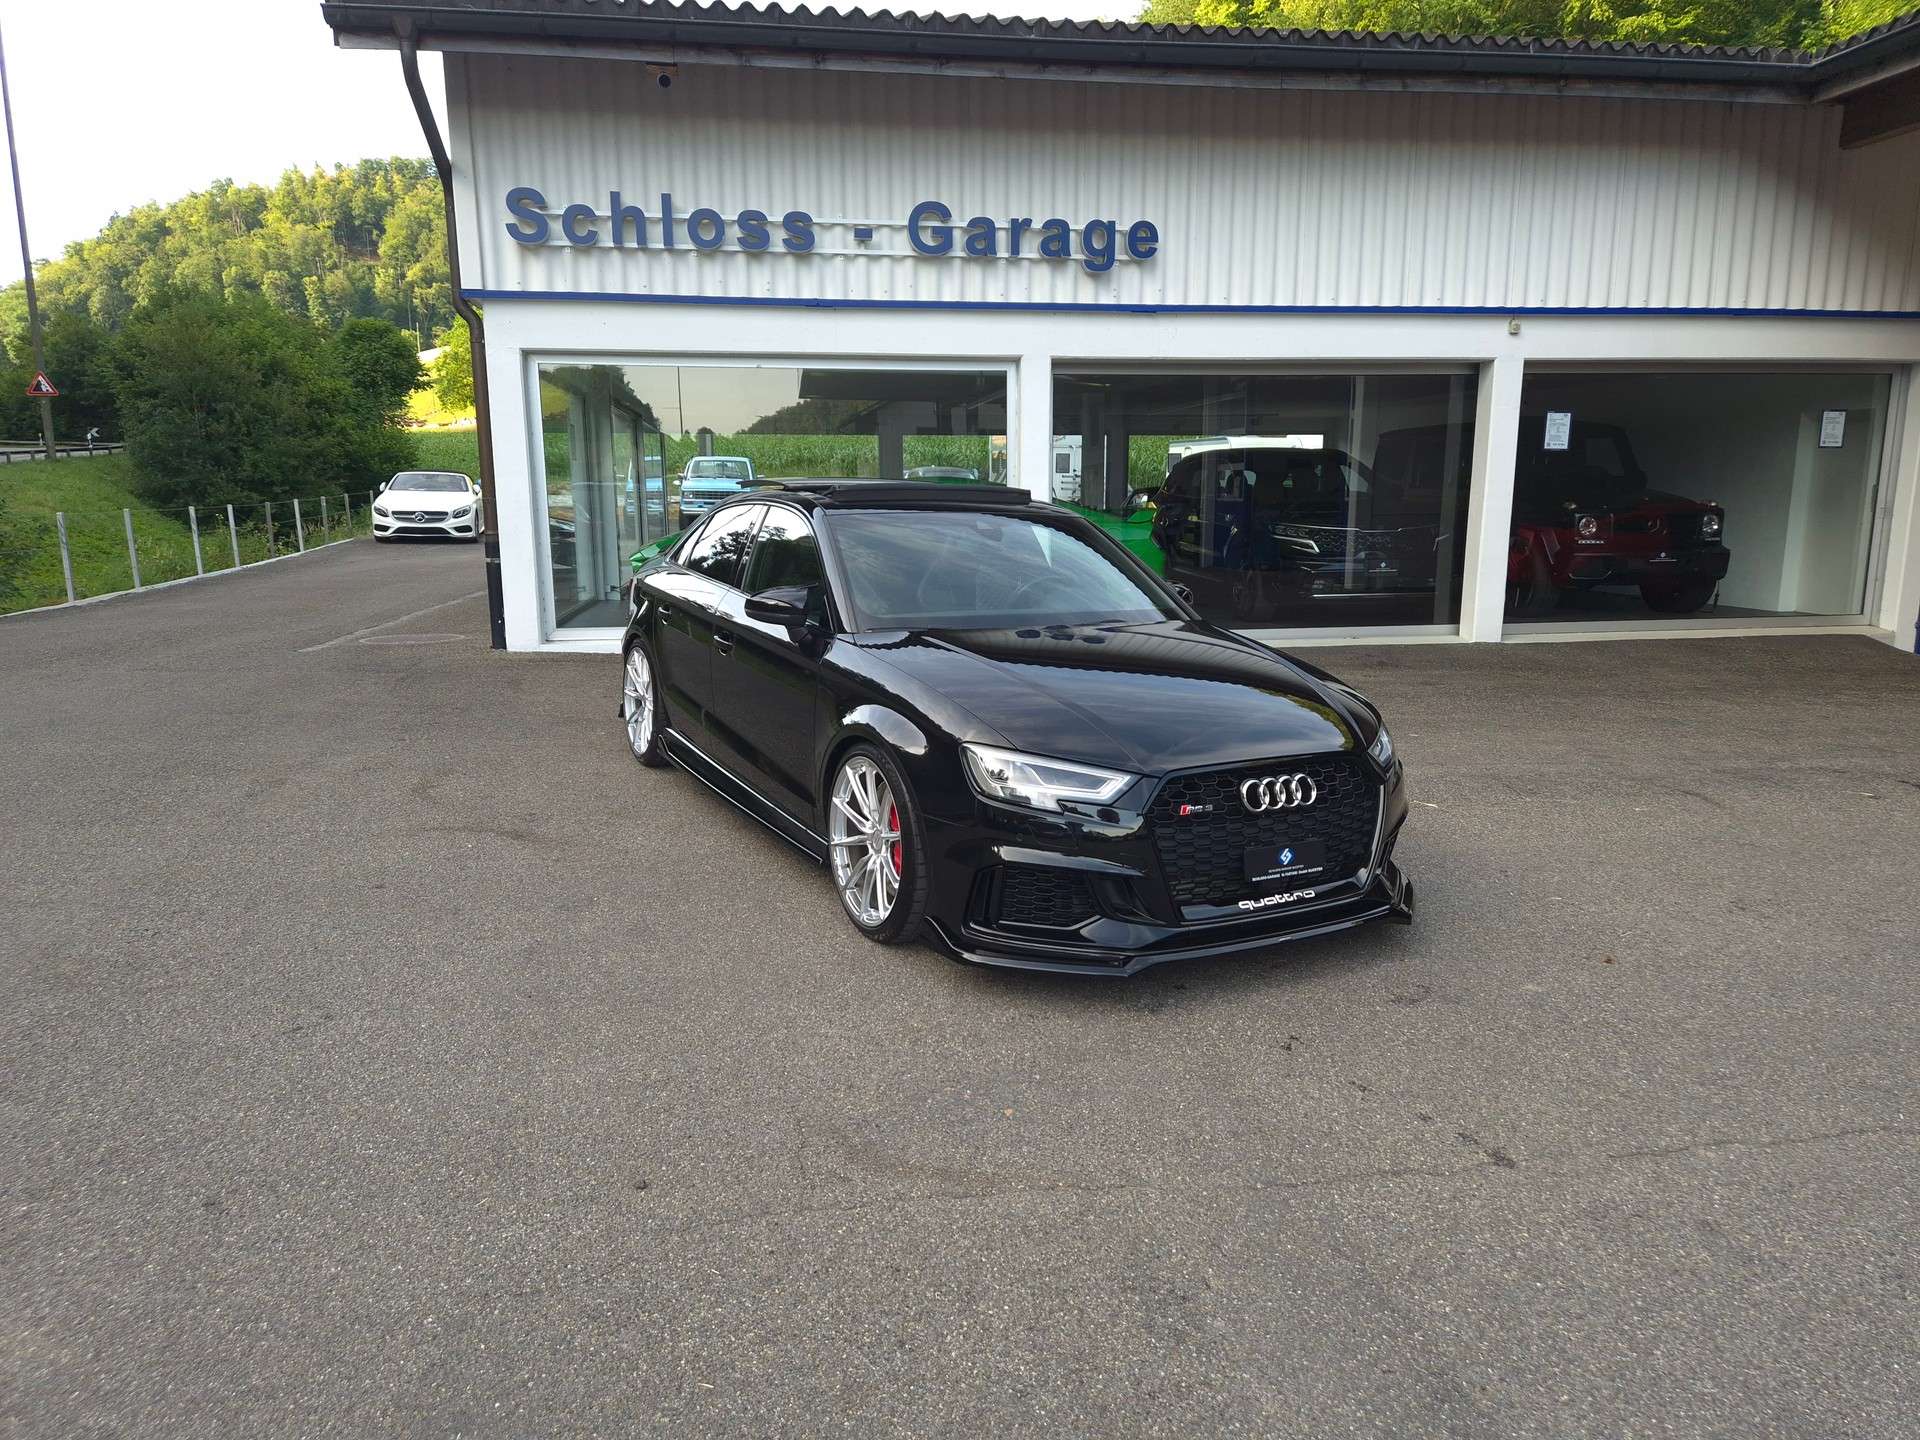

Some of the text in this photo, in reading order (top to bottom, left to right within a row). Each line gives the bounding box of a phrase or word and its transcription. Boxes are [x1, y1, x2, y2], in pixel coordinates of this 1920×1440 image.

[505, 186, 817, 252] Schloss
[907, 200, 1160, 274] Garage
[1238, 890, 1316, 911] quattro
